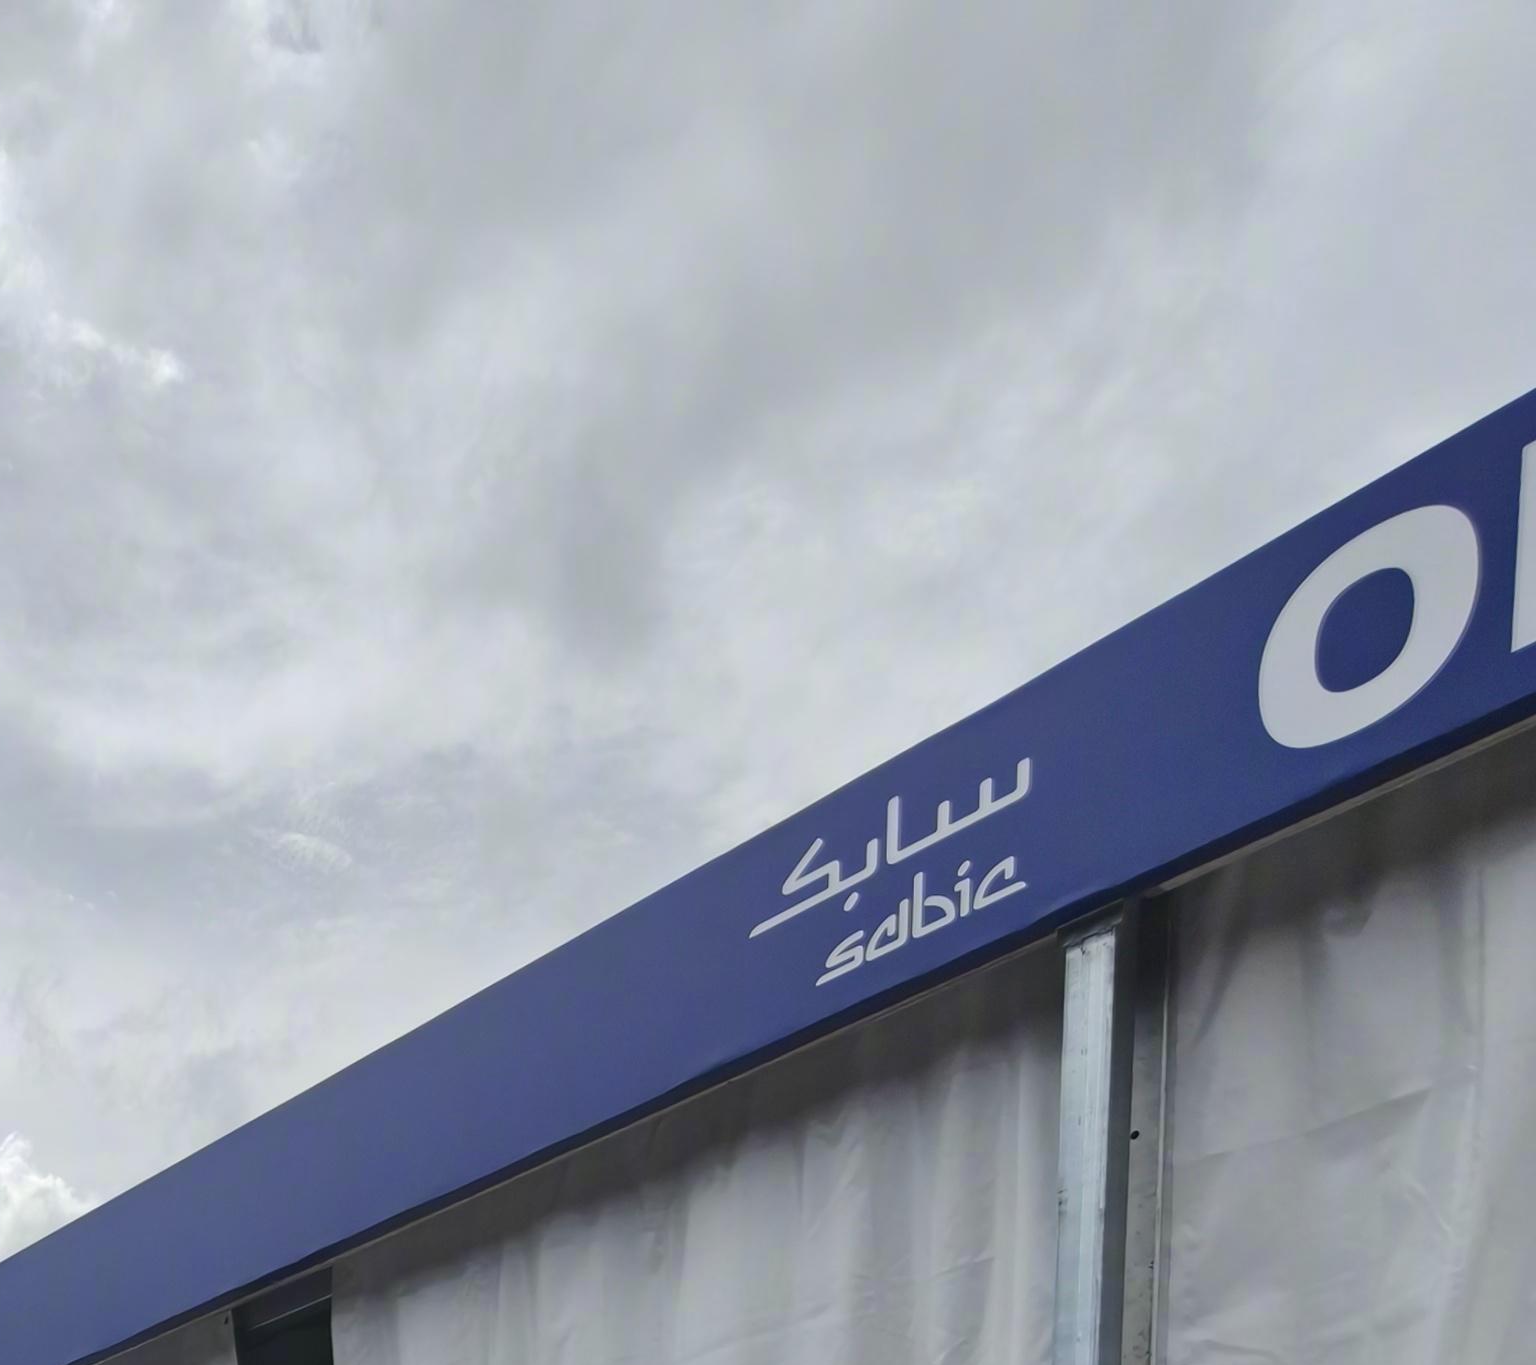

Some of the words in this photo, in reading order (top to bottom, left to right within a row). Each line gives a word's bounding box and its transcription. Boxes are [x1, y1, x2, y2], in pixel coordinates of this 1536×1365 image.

[1258, 440, 1536, 749] O
[749, 757, 1031, 939] سابك
[815, 856, 1027, 986] sabic
